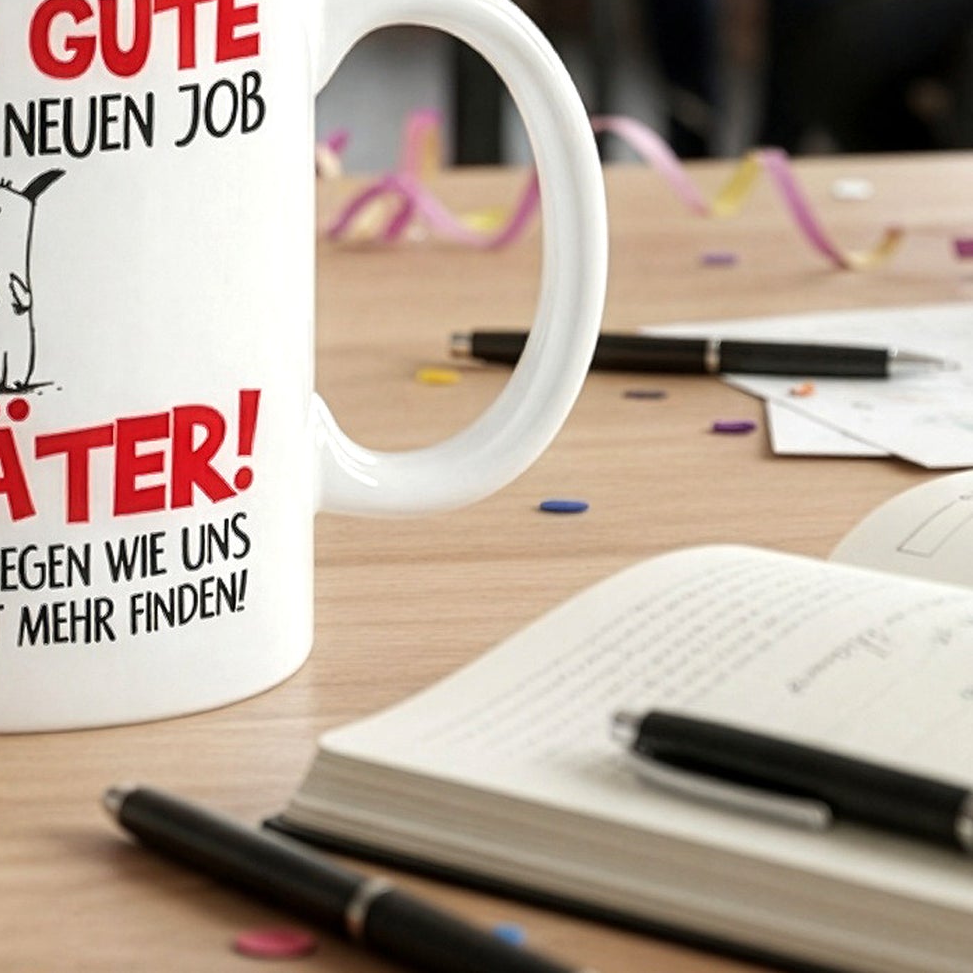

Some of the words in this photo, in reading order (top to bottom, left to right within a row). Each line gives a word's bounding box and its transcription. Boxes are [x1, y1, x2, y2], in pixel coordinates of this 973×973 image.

[4, 91, 154, 159] NEUEN
[174, 70, 266, 148] JOB
[105, 531, 167, 583] WIE
[181, 512, 251, 571] UNS
[17, 597, 116, 647] MEHR
[130, 568, 248, 636] FINDEN!
